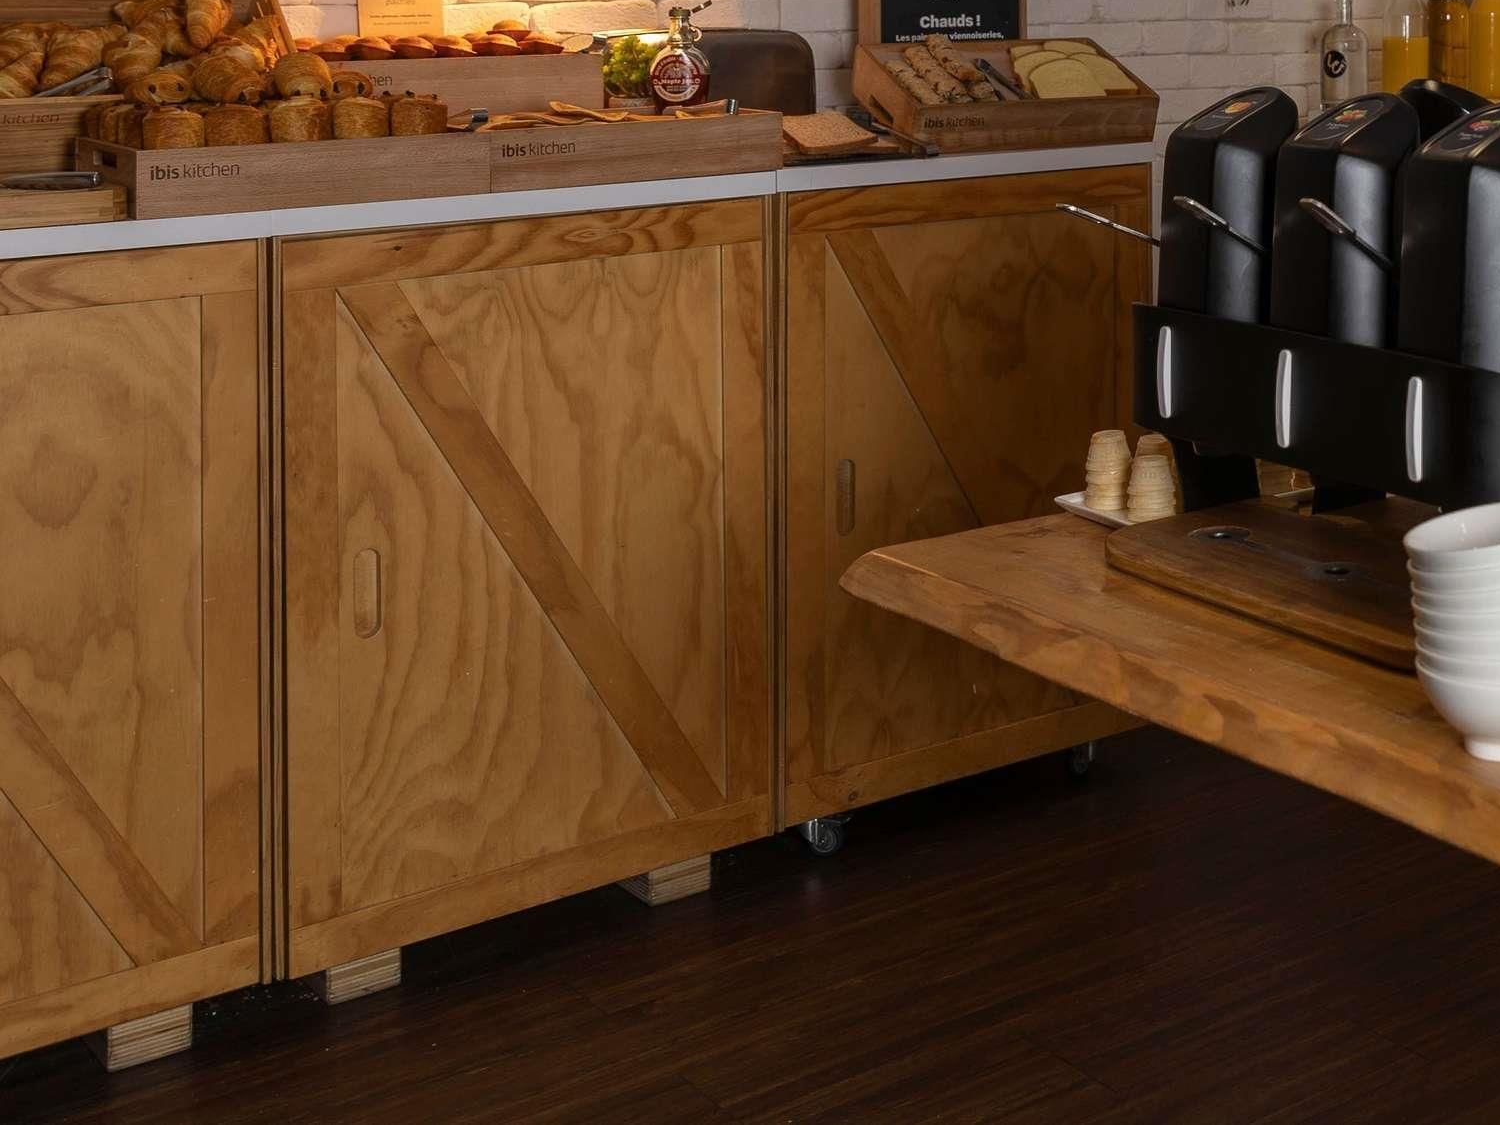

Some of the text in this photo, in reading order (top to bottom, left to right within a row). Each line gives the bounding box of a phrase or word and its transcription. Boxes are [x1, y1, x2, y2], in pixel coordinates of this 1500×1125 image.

[920, 14, 981, 28] Chauds !
[896, 34, 911, 42] Les
[949, 31, 1004, 40] viennoiseries,
[924, 116, 944, 128] ibis
[502, 140, 576, 158] ibis kitchen
[150, 162, 240, 180] ibis kitchen
